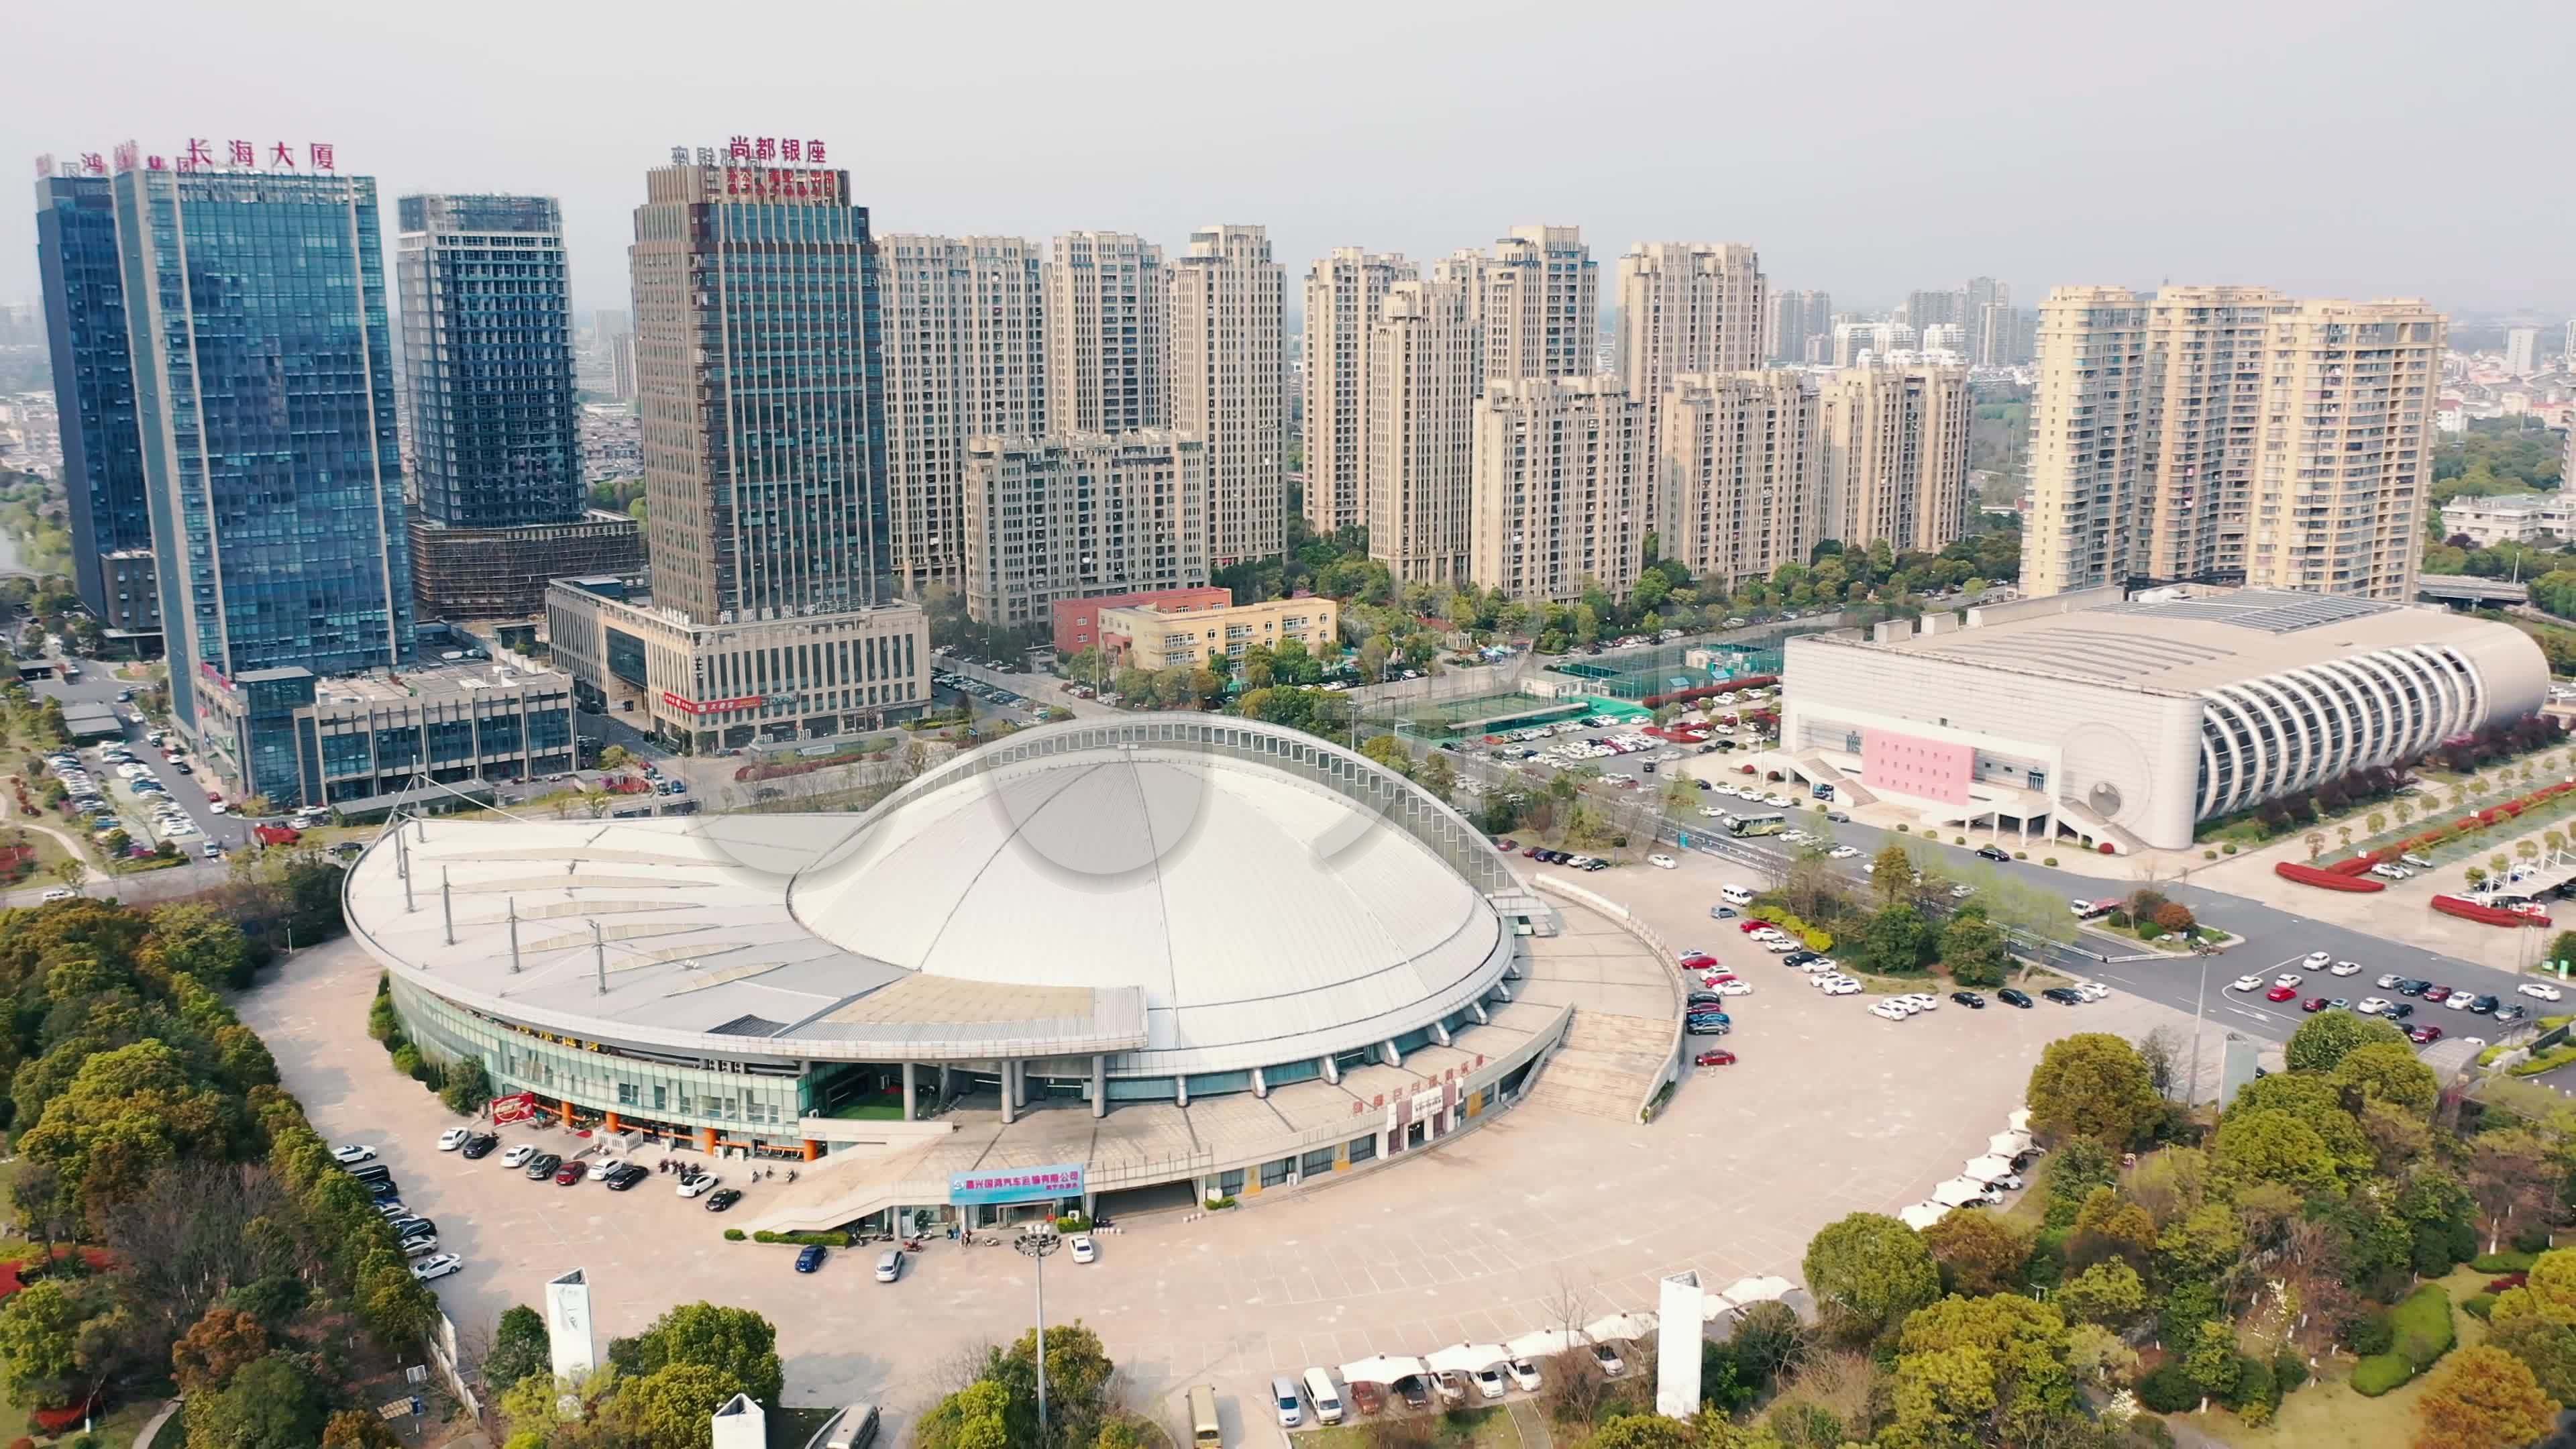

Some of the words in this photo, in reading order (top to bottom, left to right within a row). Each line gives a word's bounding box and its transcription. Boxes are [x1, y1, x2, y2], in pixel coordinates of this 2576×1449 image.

[186, 138, 335, 170] 长海大厦
[730, 135, 826, 163] 尚都银座
